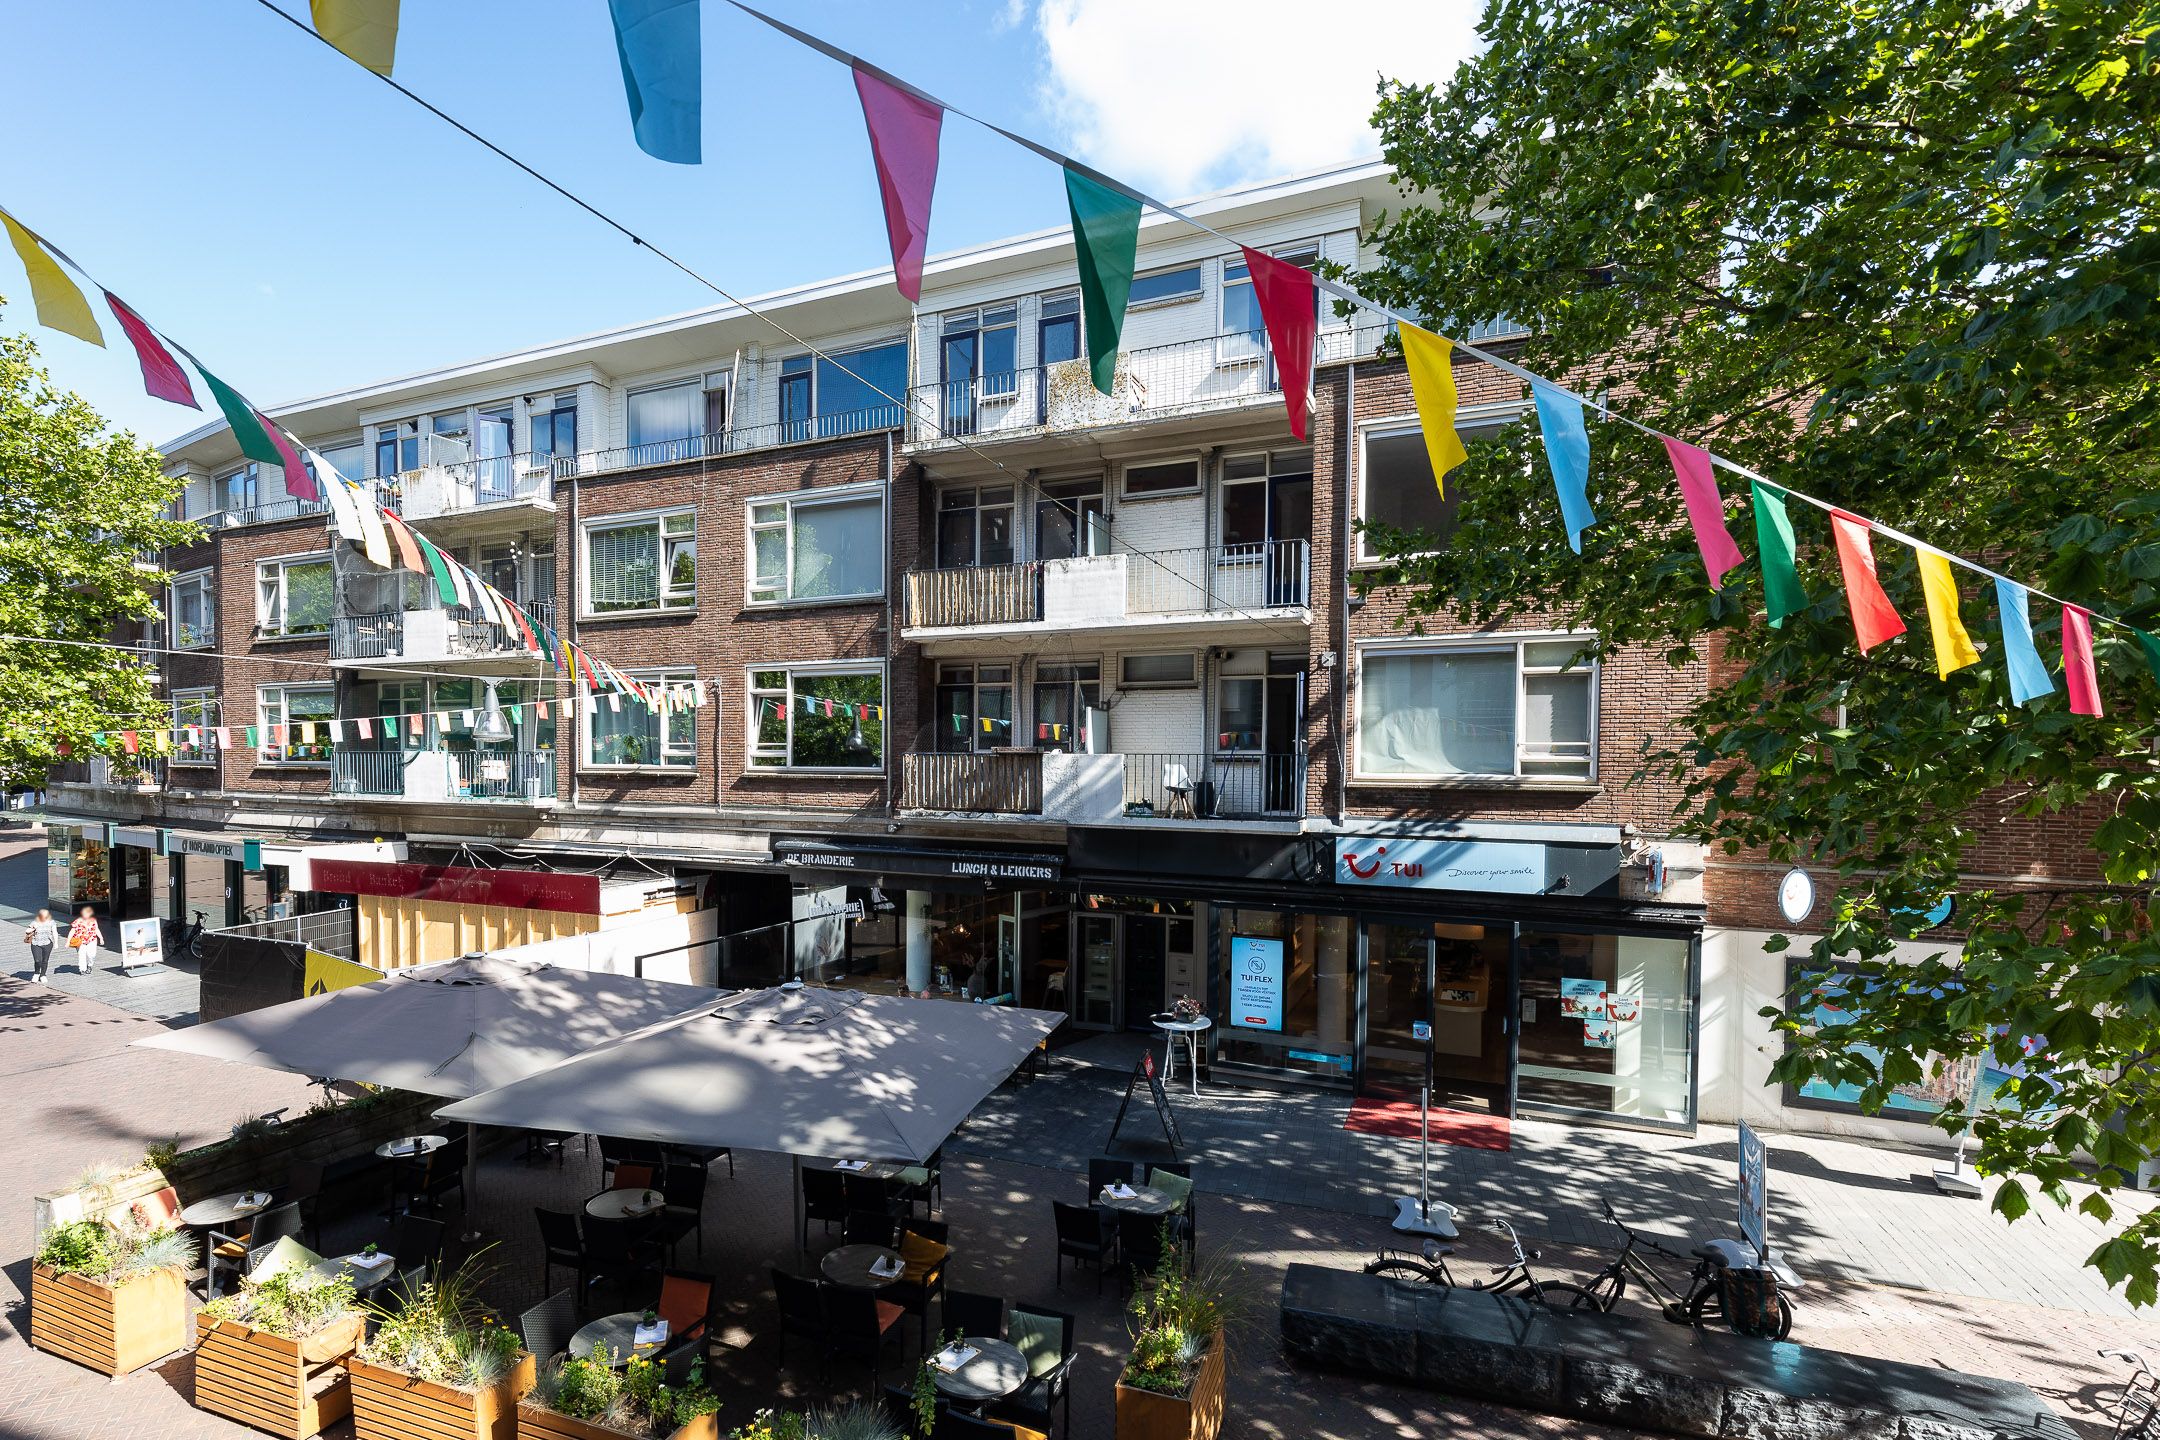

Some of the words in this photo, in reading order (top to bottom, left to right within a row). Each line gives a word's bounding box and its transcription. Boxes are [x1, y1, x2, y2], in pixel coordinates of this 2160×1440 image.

[189, 840, 215, 854] HOFLAND
[215, 844, 234, 857] OPTIEK
[801, 853, 855, 867] BRANDERIE
[951, 861, 988, 875] LUNCH
[990, 864, 998, 876] &
[1000, 865, 1052, 879] LEKKERS
[1390, 862, 1424, 878] TUI
[1445, 867, 1488, 878] Discover
[1489, 869, 1509, 881] your
[1509, 866, 1536, 876] smile
[1240, 973, 1253, 981] TUI
[1254, 975, 1273, 983] FLEX
